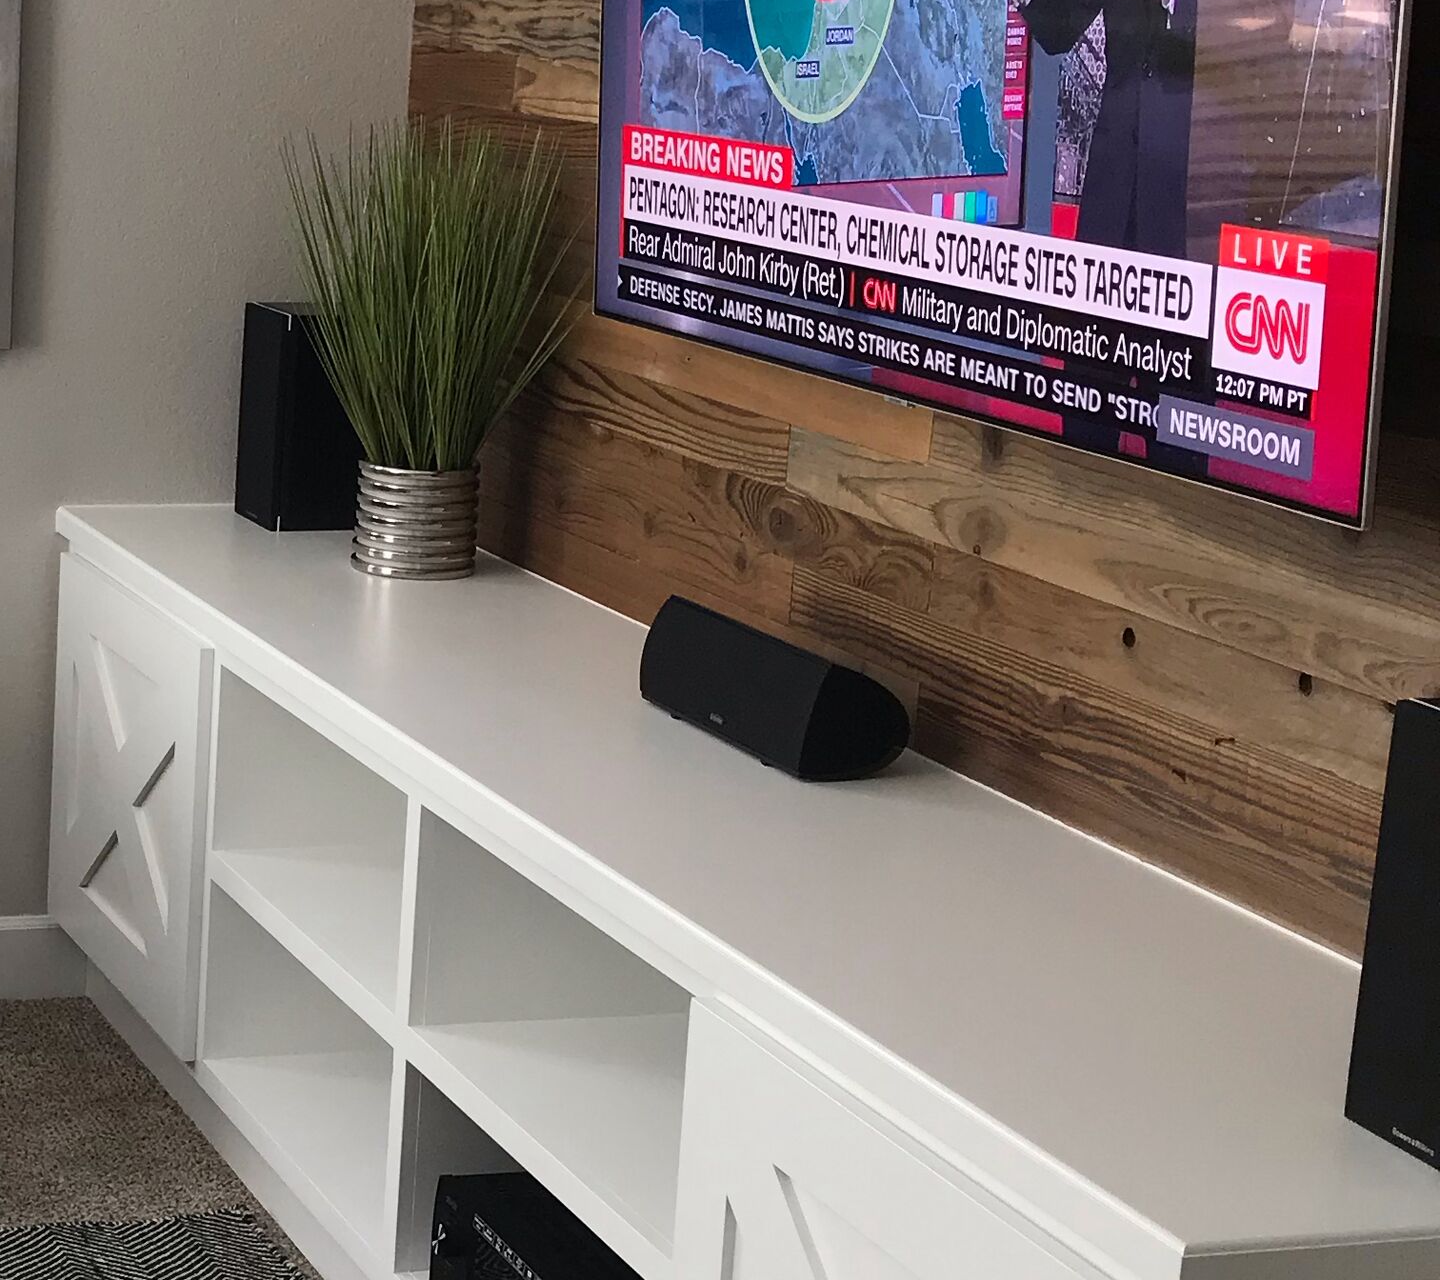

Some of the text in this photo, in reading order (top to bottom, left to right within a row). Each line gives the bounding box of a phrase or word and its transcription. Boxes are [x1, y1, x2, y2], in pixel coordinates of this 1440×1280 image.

[826, 28, 854, 43] JORDAN
[796, 62, 820, 77] ISRAEL
[630, 131, 784, 184] BREAKING NEWS
[629, 176, 1193, 322] PENTAGON: RESEARCH CENTER, CHEMICAL STORAGE SITES TARGETED
[1233, 232, 1313, 276] LIVE
[628, 225, 1192, 383] Rear Admiral John Kirby (Ret.) CNN Military and Diplomatic Analyst
[1225, 291, 1310, 365] CNN
[629, 276, 680, 306] DEFENSE
[683, 285, 718, 316] SECY.
[719, 294, 762, 327] JAMES
[766, 307, 815, 340] MATTIS
[818, 320, 854, 350] SAYS
[858, 332, 920, 367] STRIKES
[923, 347, 955, 377] ARE
[960, 356, 1019, 391] MEANT
[1024, 372, 1046, 400] TO
[1052, 378, 1101, 413] SEND
[1215, 374, 1308, 412] 12:07 PM PT
[1169, 408, 1302, 467] NEWSROOM
